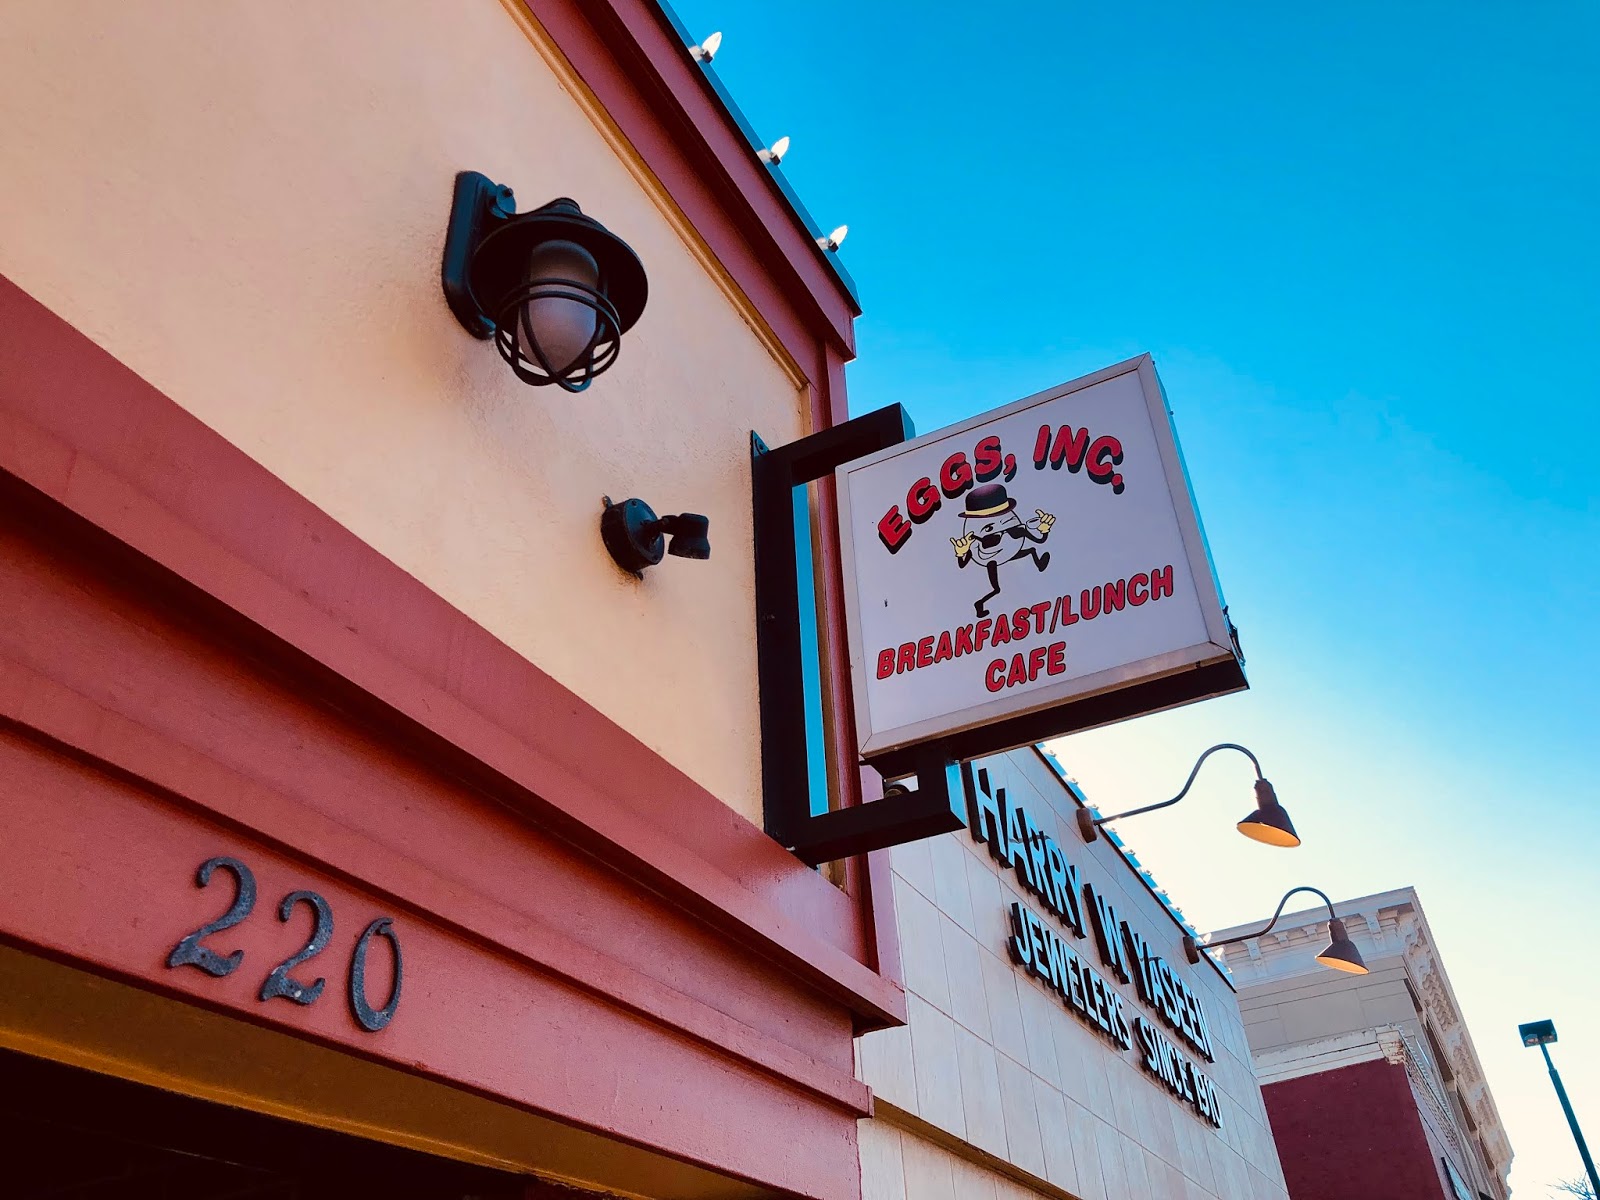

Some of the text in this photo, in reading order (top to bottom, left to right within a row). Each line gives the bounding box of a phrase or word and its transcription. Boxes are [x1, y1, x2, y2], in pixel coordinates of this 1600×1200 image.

[878, 424, 1125, 554] EGGS, INC.
[876, 564, 1174, 680] BREAKFAST/LUNCH
[984, 641, 1067, 693] CAFE
[165, 856, 404, 1032] 220
[963, 762, 1087, 939] HARRY
[1120, 920, 1216, 1063] YASEEN
[1008, 902, 1224, 1129] JEWELERS SINCE 1910
